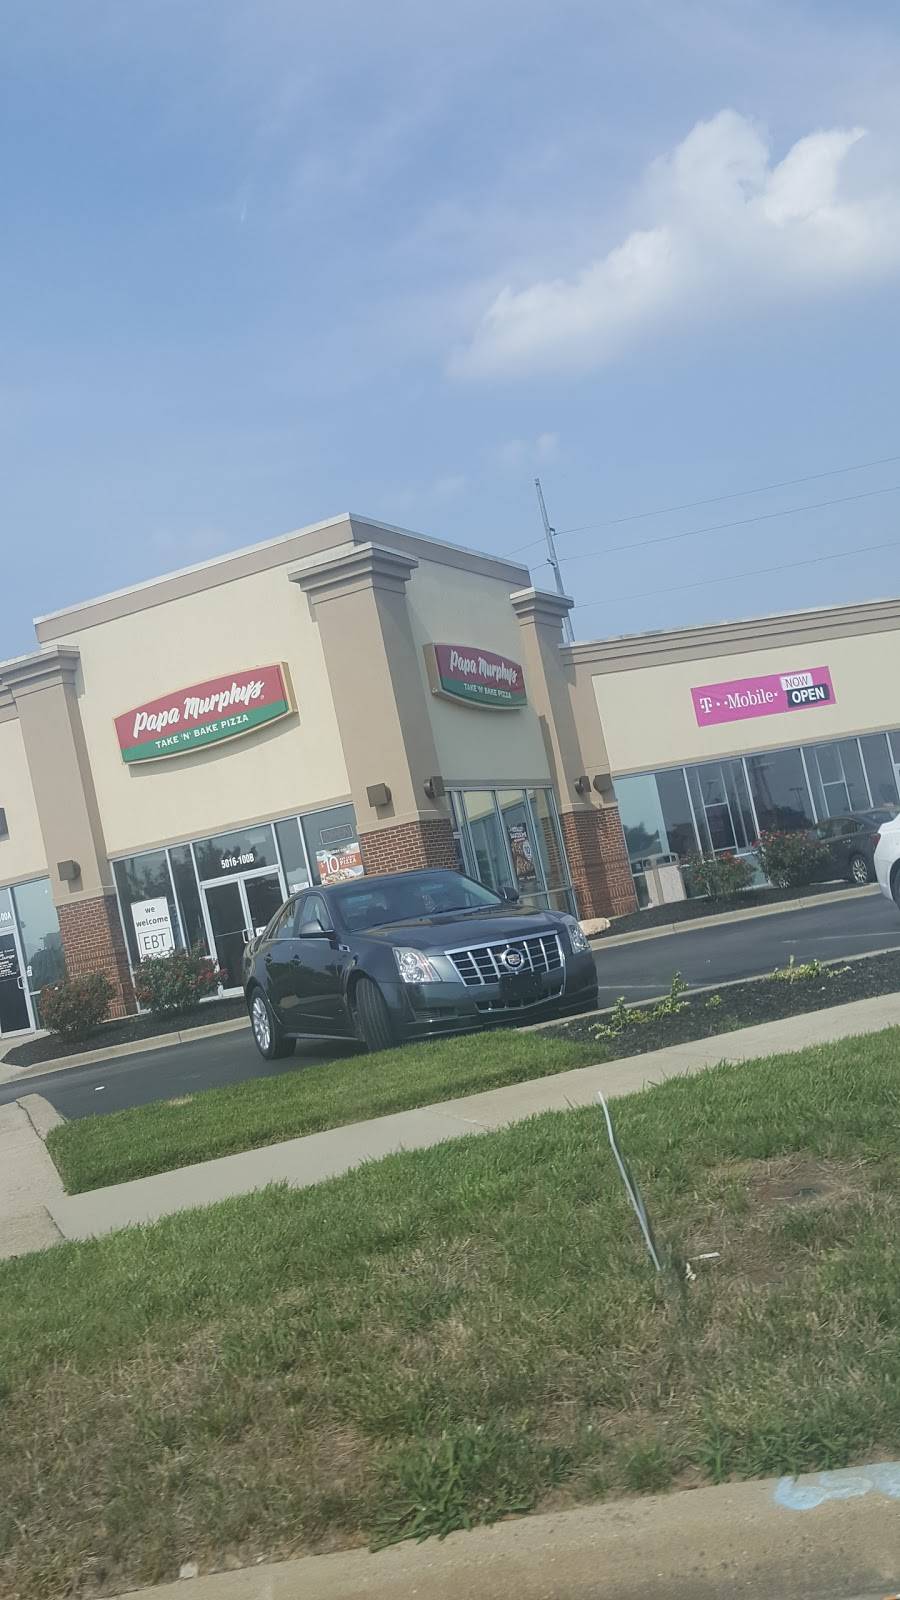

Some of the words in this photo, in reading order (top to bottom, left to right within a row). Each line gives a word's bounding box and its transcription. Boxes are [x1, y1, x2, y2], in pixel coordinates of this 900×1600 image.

[450, 649, 477, 676] Papa
[464, 683, 477, 693] TAKE
[784, 675, 808, 689] NOW
[791, 686, 825, 703] OPEN
[133, 707, 181, 738] Papa
[183, 679, 265, 719] Murphy's
[155, 735, 180, 749] TAKE
[180, 731, 192, 741] 'N'
[193, 723, 219, 738] BAKE
[220, 714, 249, 729] PIZZA
[220, 852, 255, 869] 5016-100B
[144, 906, 156, 914] we
[135, 915, 169, 928] welcome
[143, 932, 166, 950] EBT
